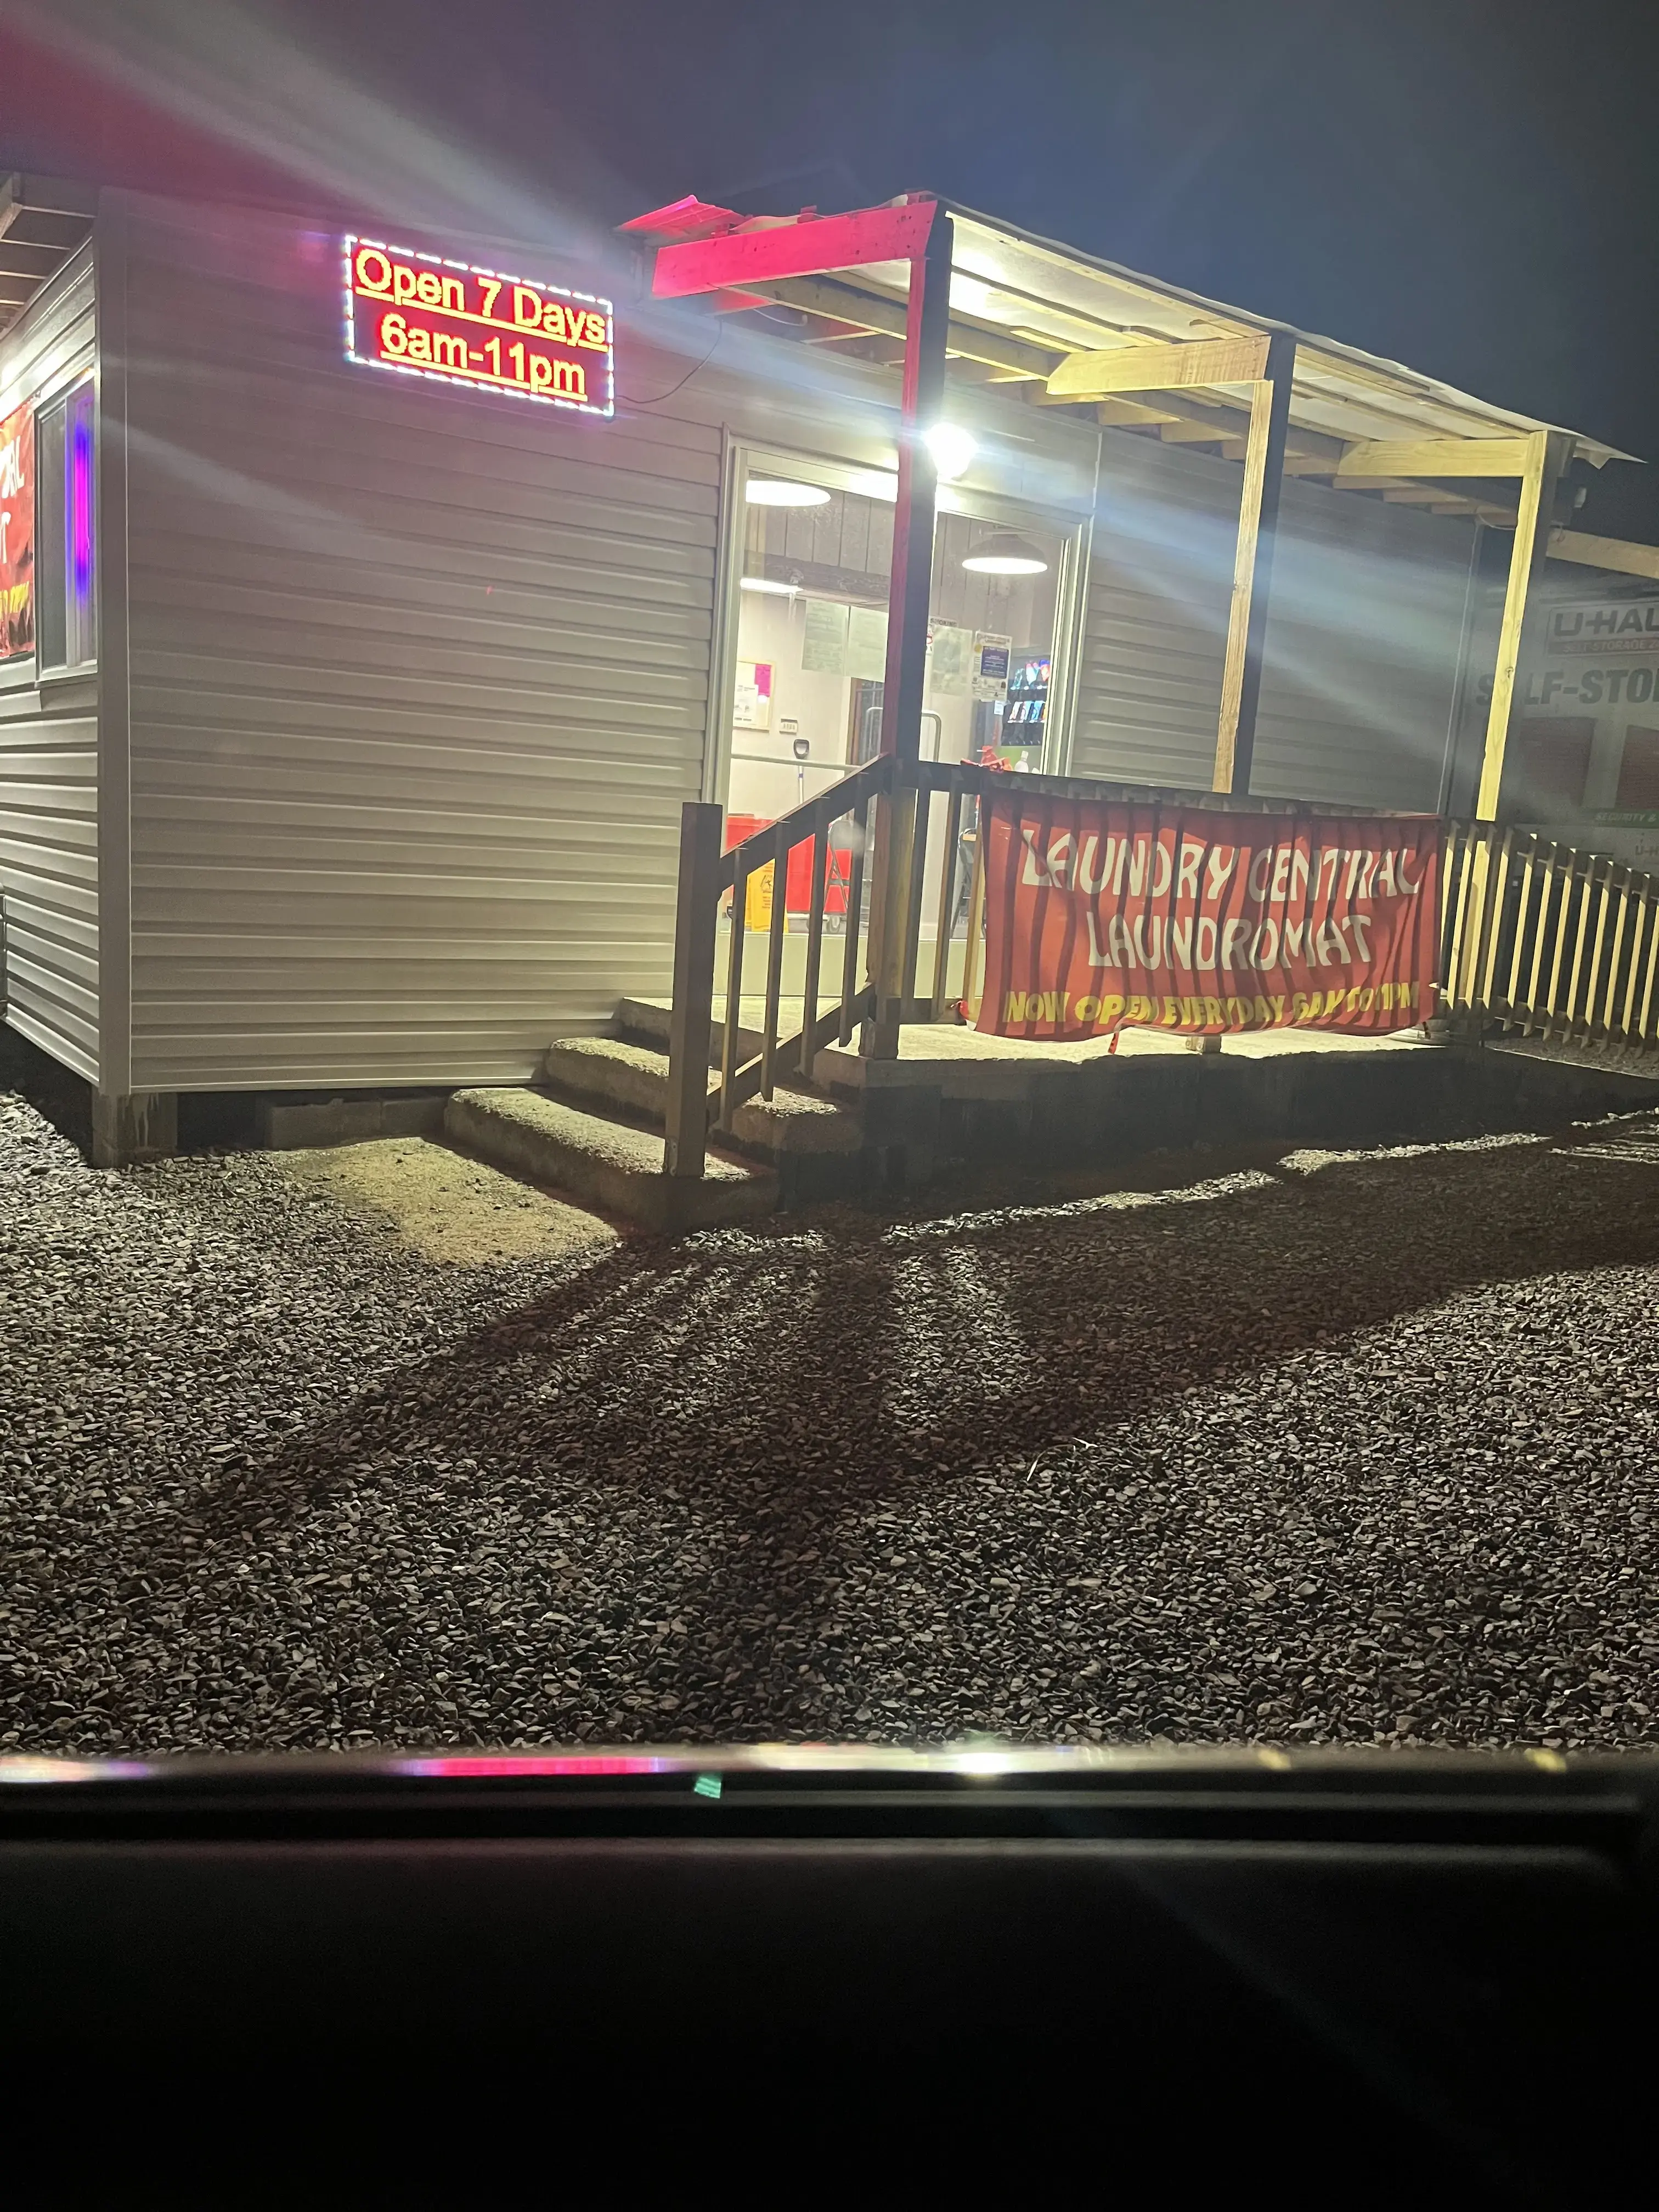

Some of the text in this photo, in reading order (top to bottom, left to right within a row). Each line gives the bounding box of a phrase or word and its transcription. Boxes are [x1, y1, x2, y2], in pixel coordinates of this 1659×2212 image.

[356, 248, 606, 346] Open 7 Days
[381, 313, 585, 394] 6am-11pm
[1022, 830, 1420, 902] LAUNDRY CENTRAL
[1086, 911, 1372, 970] LAUNDROMAT
[1002, 991, 1070, 1023] NOW
[1074, 994, 1160, 1024] OPEN
[1161, 995, 1285, 1025] EVERYDAY
